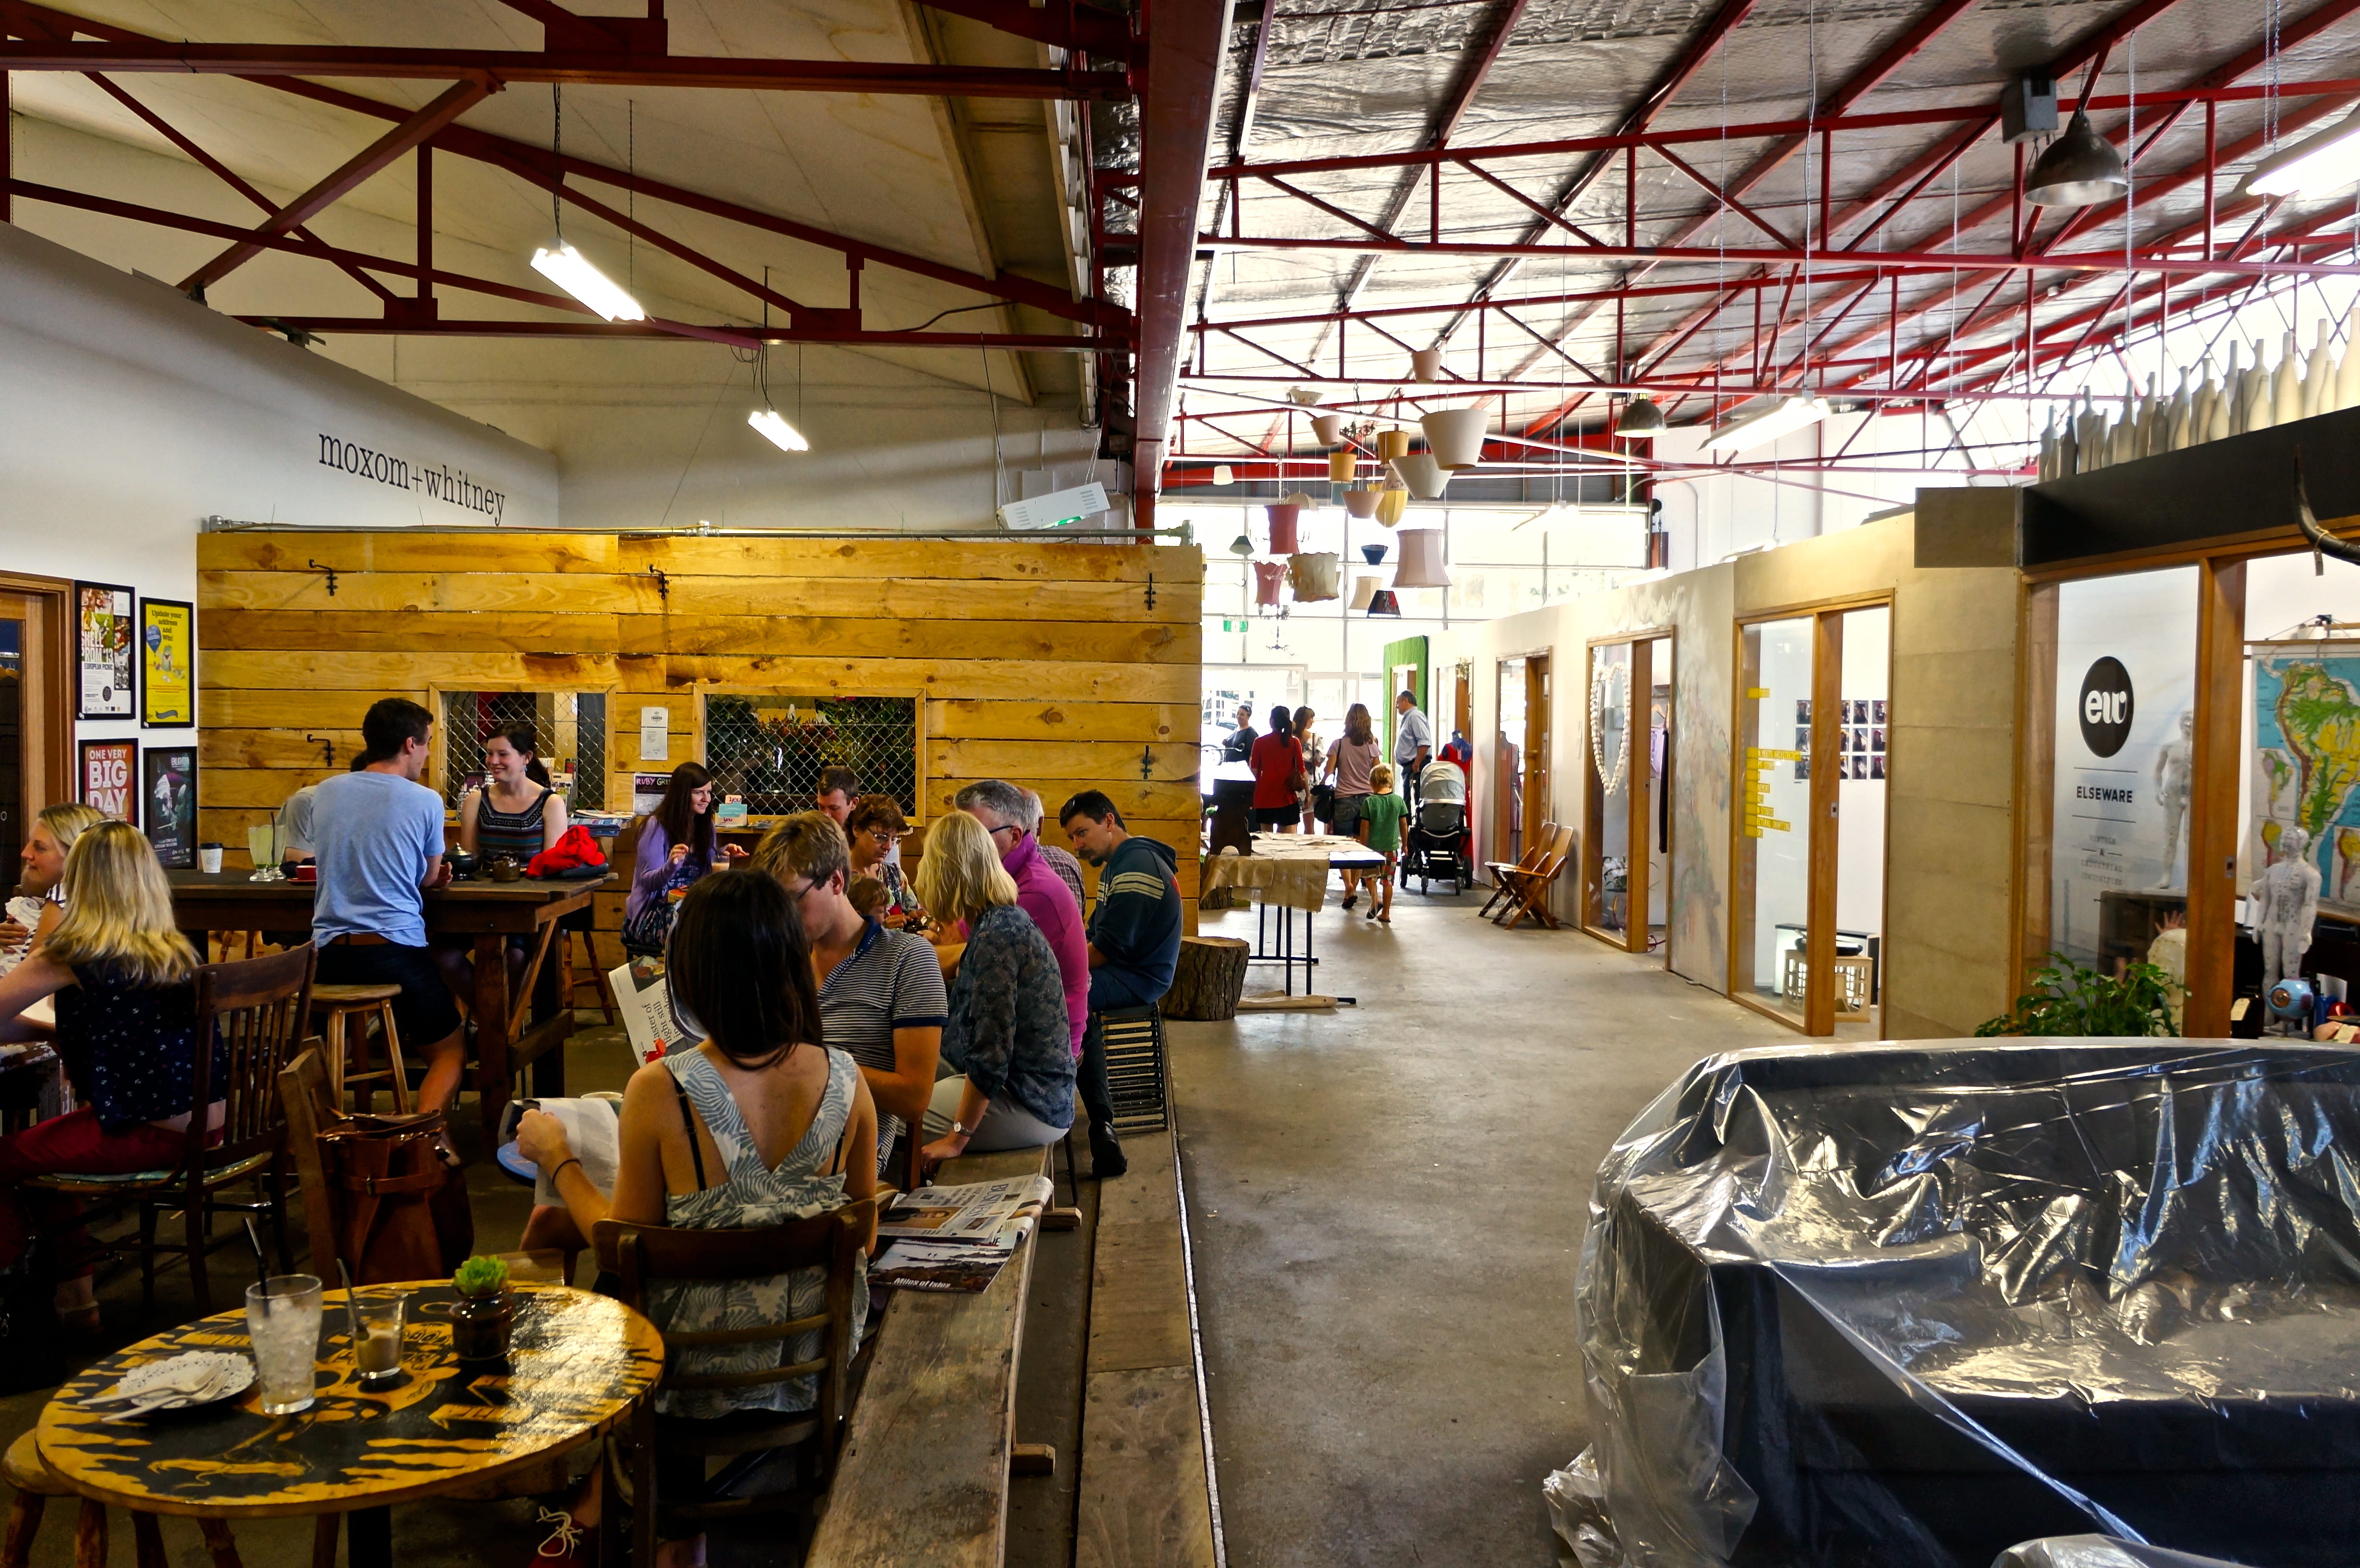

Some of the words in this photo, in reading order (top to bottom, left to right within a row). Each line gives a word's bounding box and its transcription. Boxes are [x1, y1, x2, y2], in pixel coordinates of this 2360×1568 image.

[89, 749, 106, 760] ONE
[107, 749, 127, 759] VERY
[89, 760, 127, 789] BIG
[89, 788, 127, 814] DAY
[2076, 786, 2133, 804] ELSEWARE
[641, 1003, 652, 1013] of
[653, 1001, 665, 1018] still
[648, 1016, 661, 1043] aster
[661, 1019, 672, 1044] light
